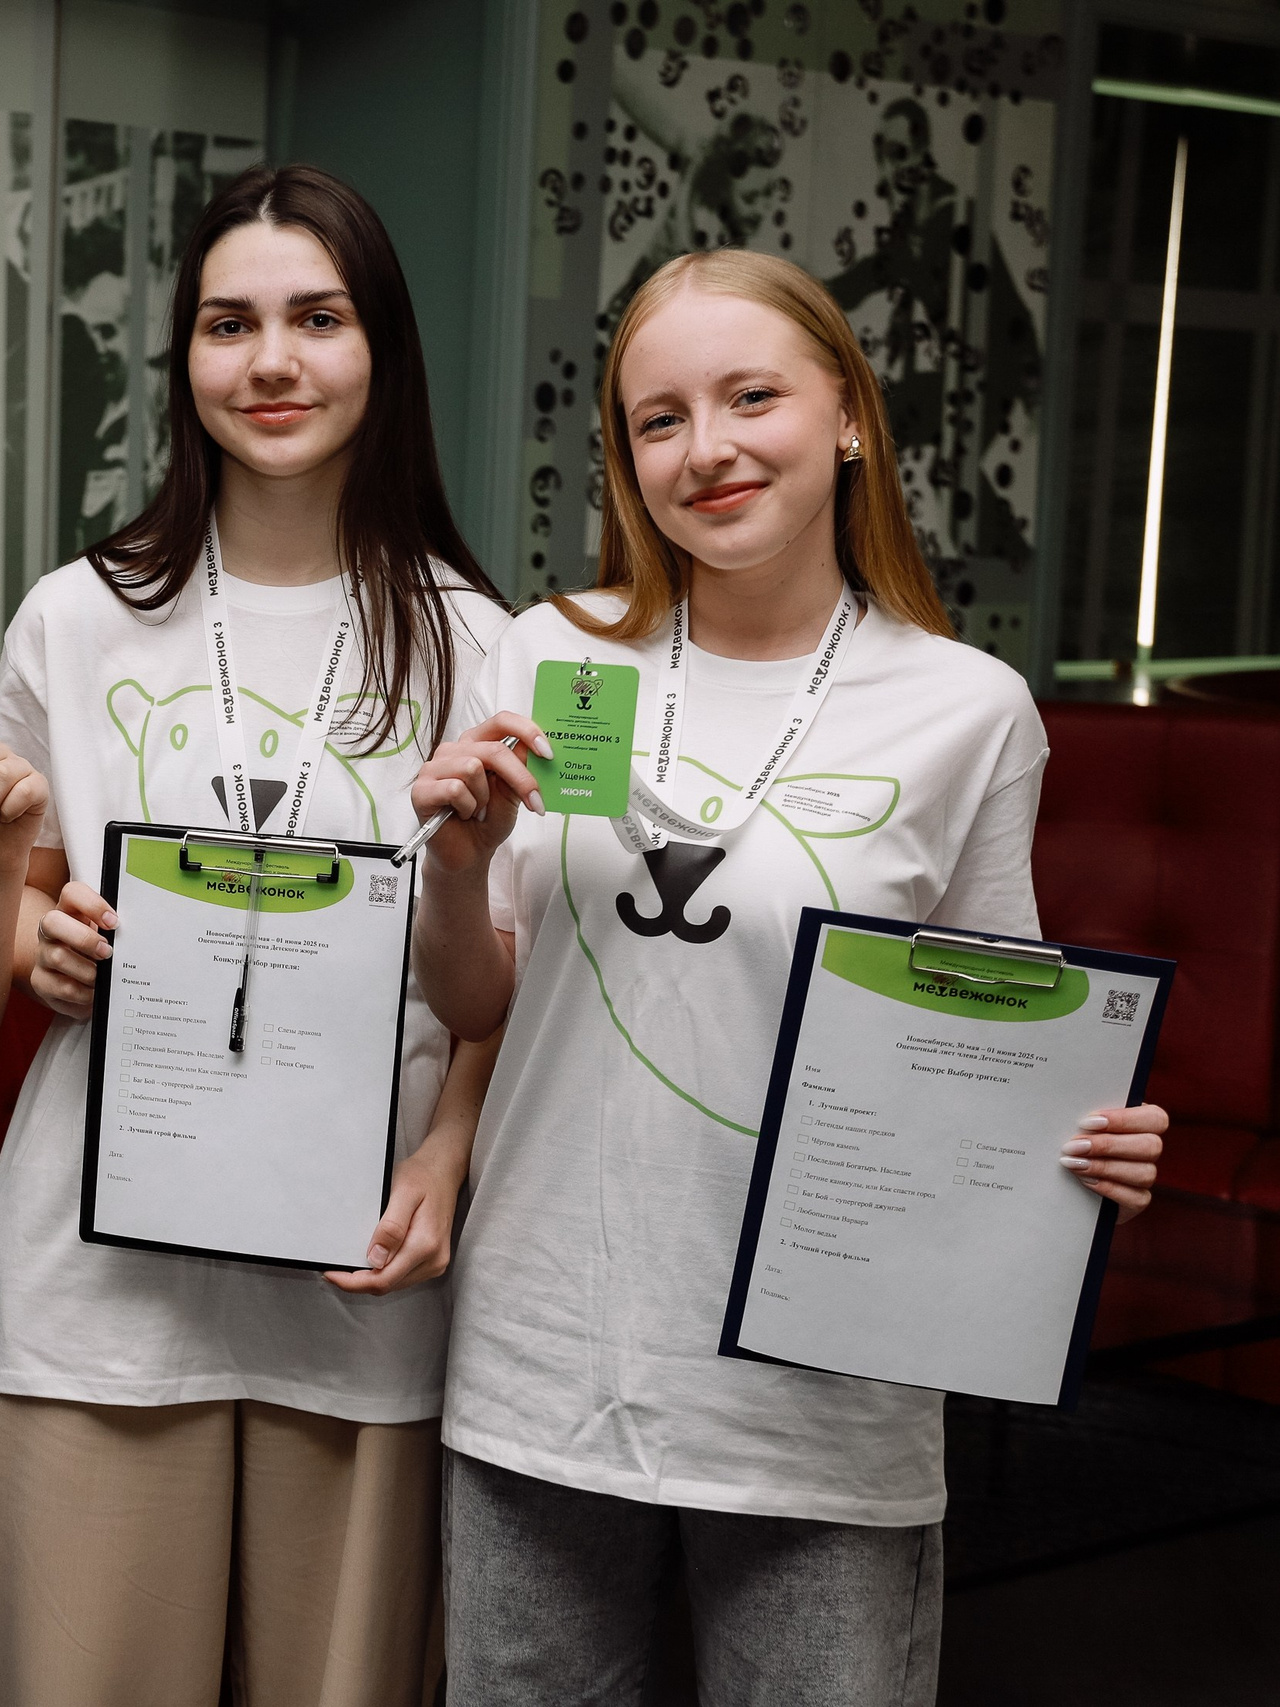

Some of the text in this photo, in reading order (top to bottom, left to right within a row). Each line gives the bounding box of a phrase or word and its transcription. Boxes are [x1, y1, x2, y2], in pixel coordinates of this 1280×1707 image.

[204, 521, 218, 596] медвежон
[214, 631, 234, 724] медвежонок
[314, 630, 347, 722] медвежонок
[807, 602, 851, 695] медвежонок 3
[559, 772, 596, 782] Ущенко
[564, 761, 592, 770] Ольга
[656, 702, 675, 783] медвежонок
[746, 726, 798, 799] медвежонок
[234, 774, 249, 832] ежонок
[560, 787, 592, 797] ЖЮРИ
[913, 982, 1028, 1009] медвежонок
